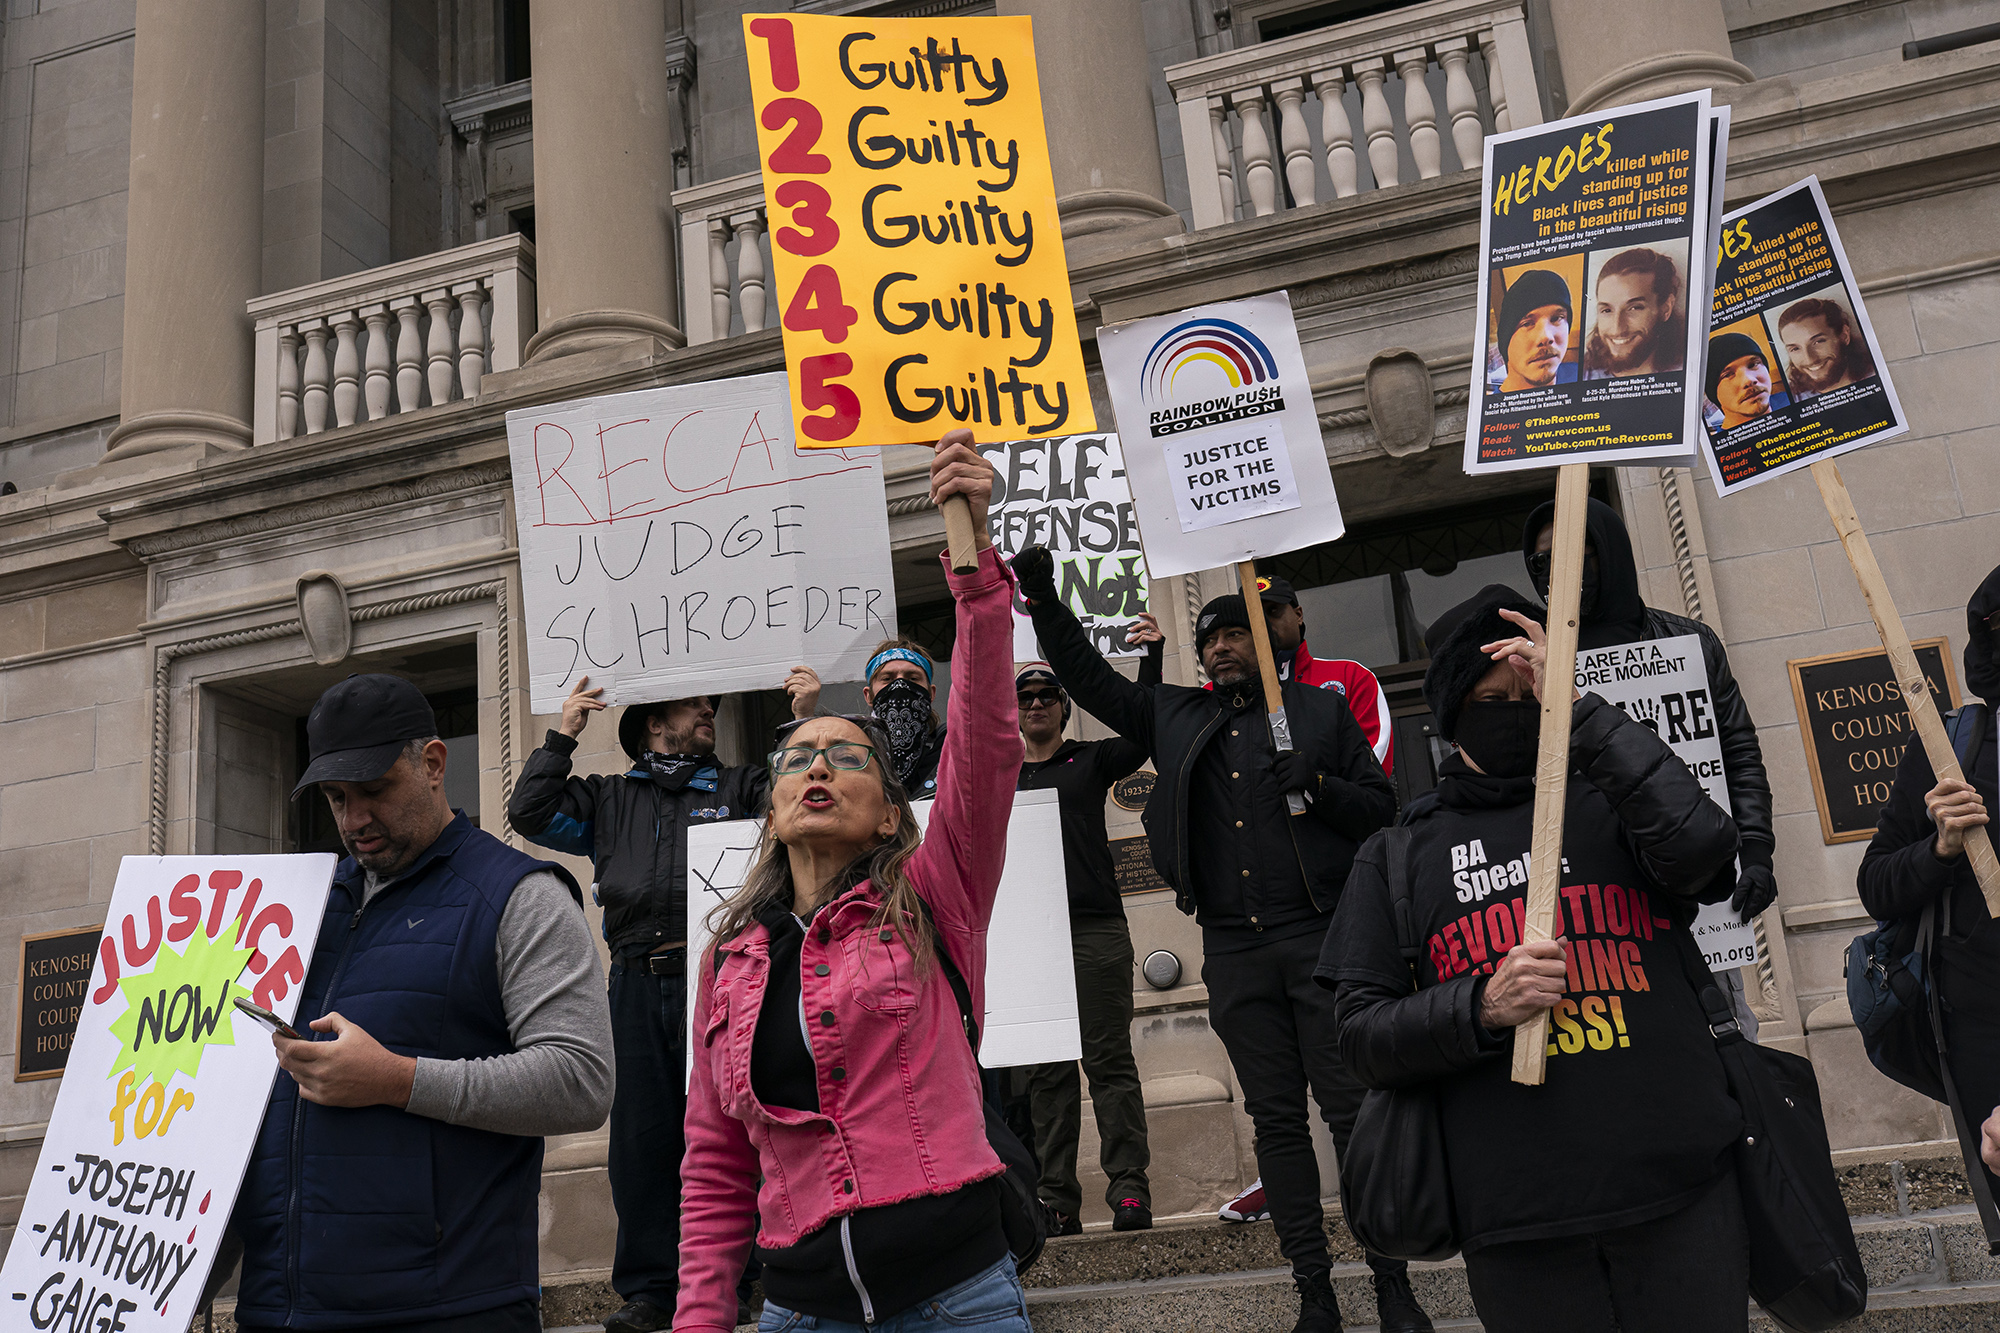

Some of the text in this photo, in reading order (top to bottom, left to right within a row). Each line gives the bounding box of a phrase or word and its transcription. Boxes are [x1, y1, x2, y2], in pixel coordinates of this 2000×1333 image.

[750, 18, 1008, 105] 1 Guilty
[761, 98, 1019, 192] 2 Guilty
[1606, 148, 1689, 174] killed while
[1492, 123, 1613, 216] HEROES
[1582, 166, 1689, 196] standing up for
[1533, 184, 1688, 222] Black lives and justice
[1539, 201, 1687, 237] in the beautiful rising
[775, 180, 1033, 267] 3 Guilty
[1492, 244, 1520, 255] Protesters
[1521, 242, 1534, 250] have
[1551, 233, 1575, 243] attacked
[1585, 228, 1605, 237] fascist
[1606, 224, 1623, 233] white
[1625, 219, 1663, 231] supremacist
[1752, 221, 1818, 254] killed while
[1492, 255, 1503, 263] who
[1505, 252, 1521, 260] Trump
[1523, 248, 1540, 257] called
[1713, 245, 1827, 296] ack lives and justice
[1738, 232, 1822, 274] standing up for
[1724, 293, 1743, 305] the
[1745, 271, 1796, 297] beautiful
[1799, 257, 1833, 277] rising
[783, 264, 1053, 367] 4 Guilty
[800, 352, 1069, 441] 5 Guilty
[1158, 403, 1276, 434] COALITION
[1482, 423, 1611, 446] Read: www.revcom.us
[1483, 411, 1600, 433] Follow: @TheRevcoms
[1183, 437, 1269, 468] JUSTICE
[1482, 431, 1673, 458] Watch: YouTube.com/TheRevcoms
[1720, 447, 1752, 463] Follow:
[1755, 421, 1821, 450] @TheRevcoms
[1723, 458, 1748, 473] Read:
[1760, 427, 1834, 458] www.revcom.us
[1726, 466, 1756, 482] Watch:
[1763, 419, 1888, 467] YouTube.com/TheRevcoms
[534, 409, 881, 526] RECA
[1187, 458, 1275, 490] FOR THE
[1190, 479, 1281, 511] VICTIMS
[555, 504, 805, 586] JUDGE
[987, 501, 1141, 555] EFENSE
[1059, 555, 1149, 618] Not
[546, 585, 889, 688] SCHROEDER
[1575, 657, 1685, 688] ORE MOMENT
[1584, 651, 1620, 670] ARE
[1625, 647, 1645, 663] AT
[1651, 645, 1662, 659] A
[1816, 675, 1942, 712] KENOSA
[1831, 711, 1915, 741] COUNT
[1848, 745, 1907, 772] COU
[1114, 862, 1149, 871] NATIONAL
[1451, 839, 1487, 872] BA
[1453, 851, 1571, 904] Spea:
[93, 869, 304, 1013] JUSTICE
[1708, 925, 1720, 934] No
[30, 953, 91, 977] KENOSH
[38, 1006, 83, 1027] COUR
[133, 979, 229, 1052] NOW
[37, 1032, 76, 1052] HOUS
[109, 1070, 195, 1146] for
